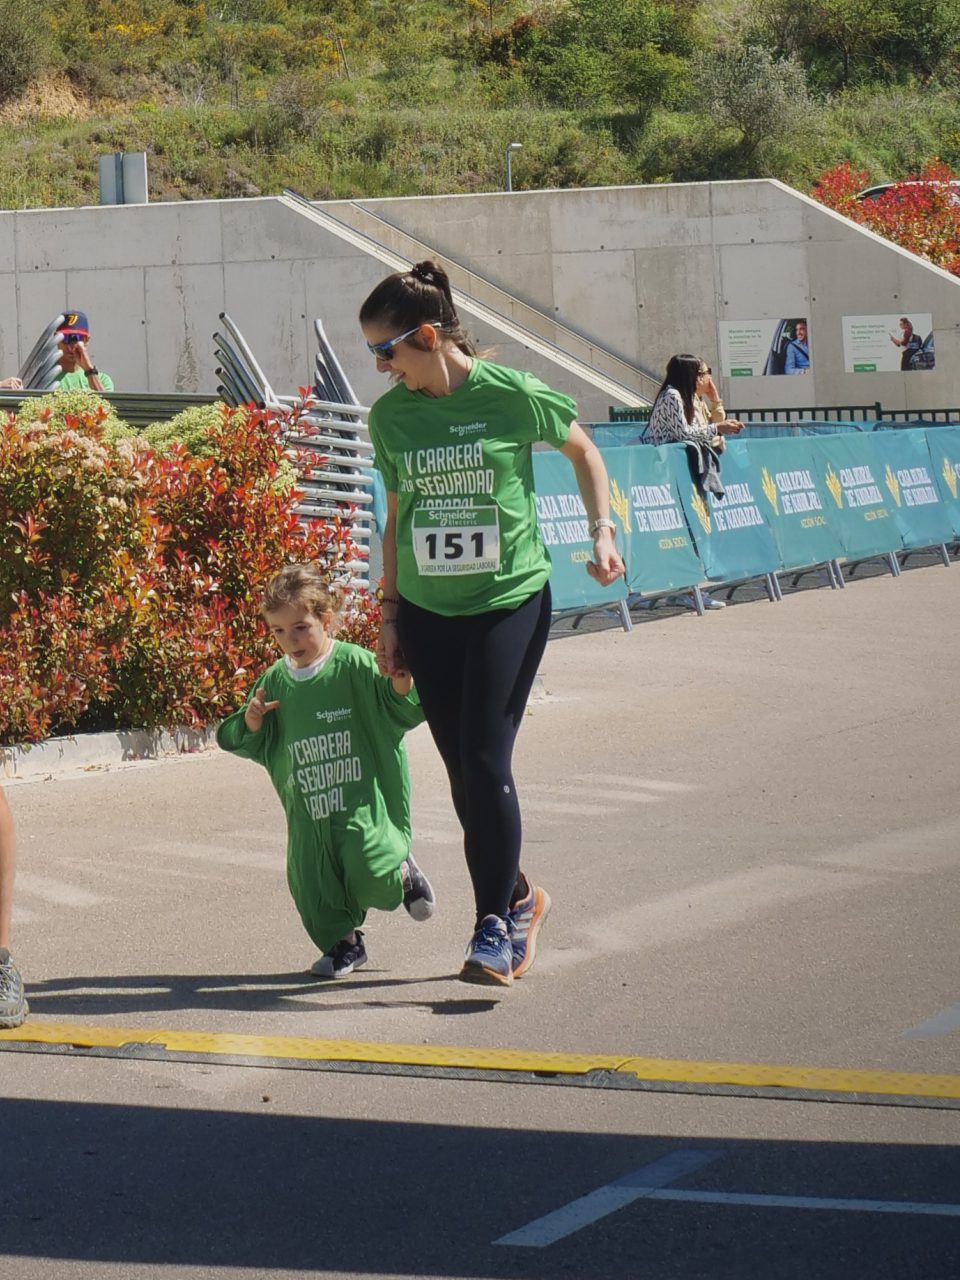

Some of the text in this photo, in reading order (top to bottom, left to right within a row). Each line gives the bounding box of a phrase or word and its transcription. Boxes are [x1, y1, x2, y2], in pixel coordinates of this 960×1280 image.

[449, 422, 487, 434] Schneider
[404, 442, 484, 476] V CARRERA
[415, 469, 495, 496] SEGURIDAD
[428, 510, 478, 522] Schneider
[540, 520, 595, 545] DE NAVAR
[425, 532, 484, 560] 151
[316, 707, 352, 721] Schneider
[294, 730, 351, 765] CARRERA
